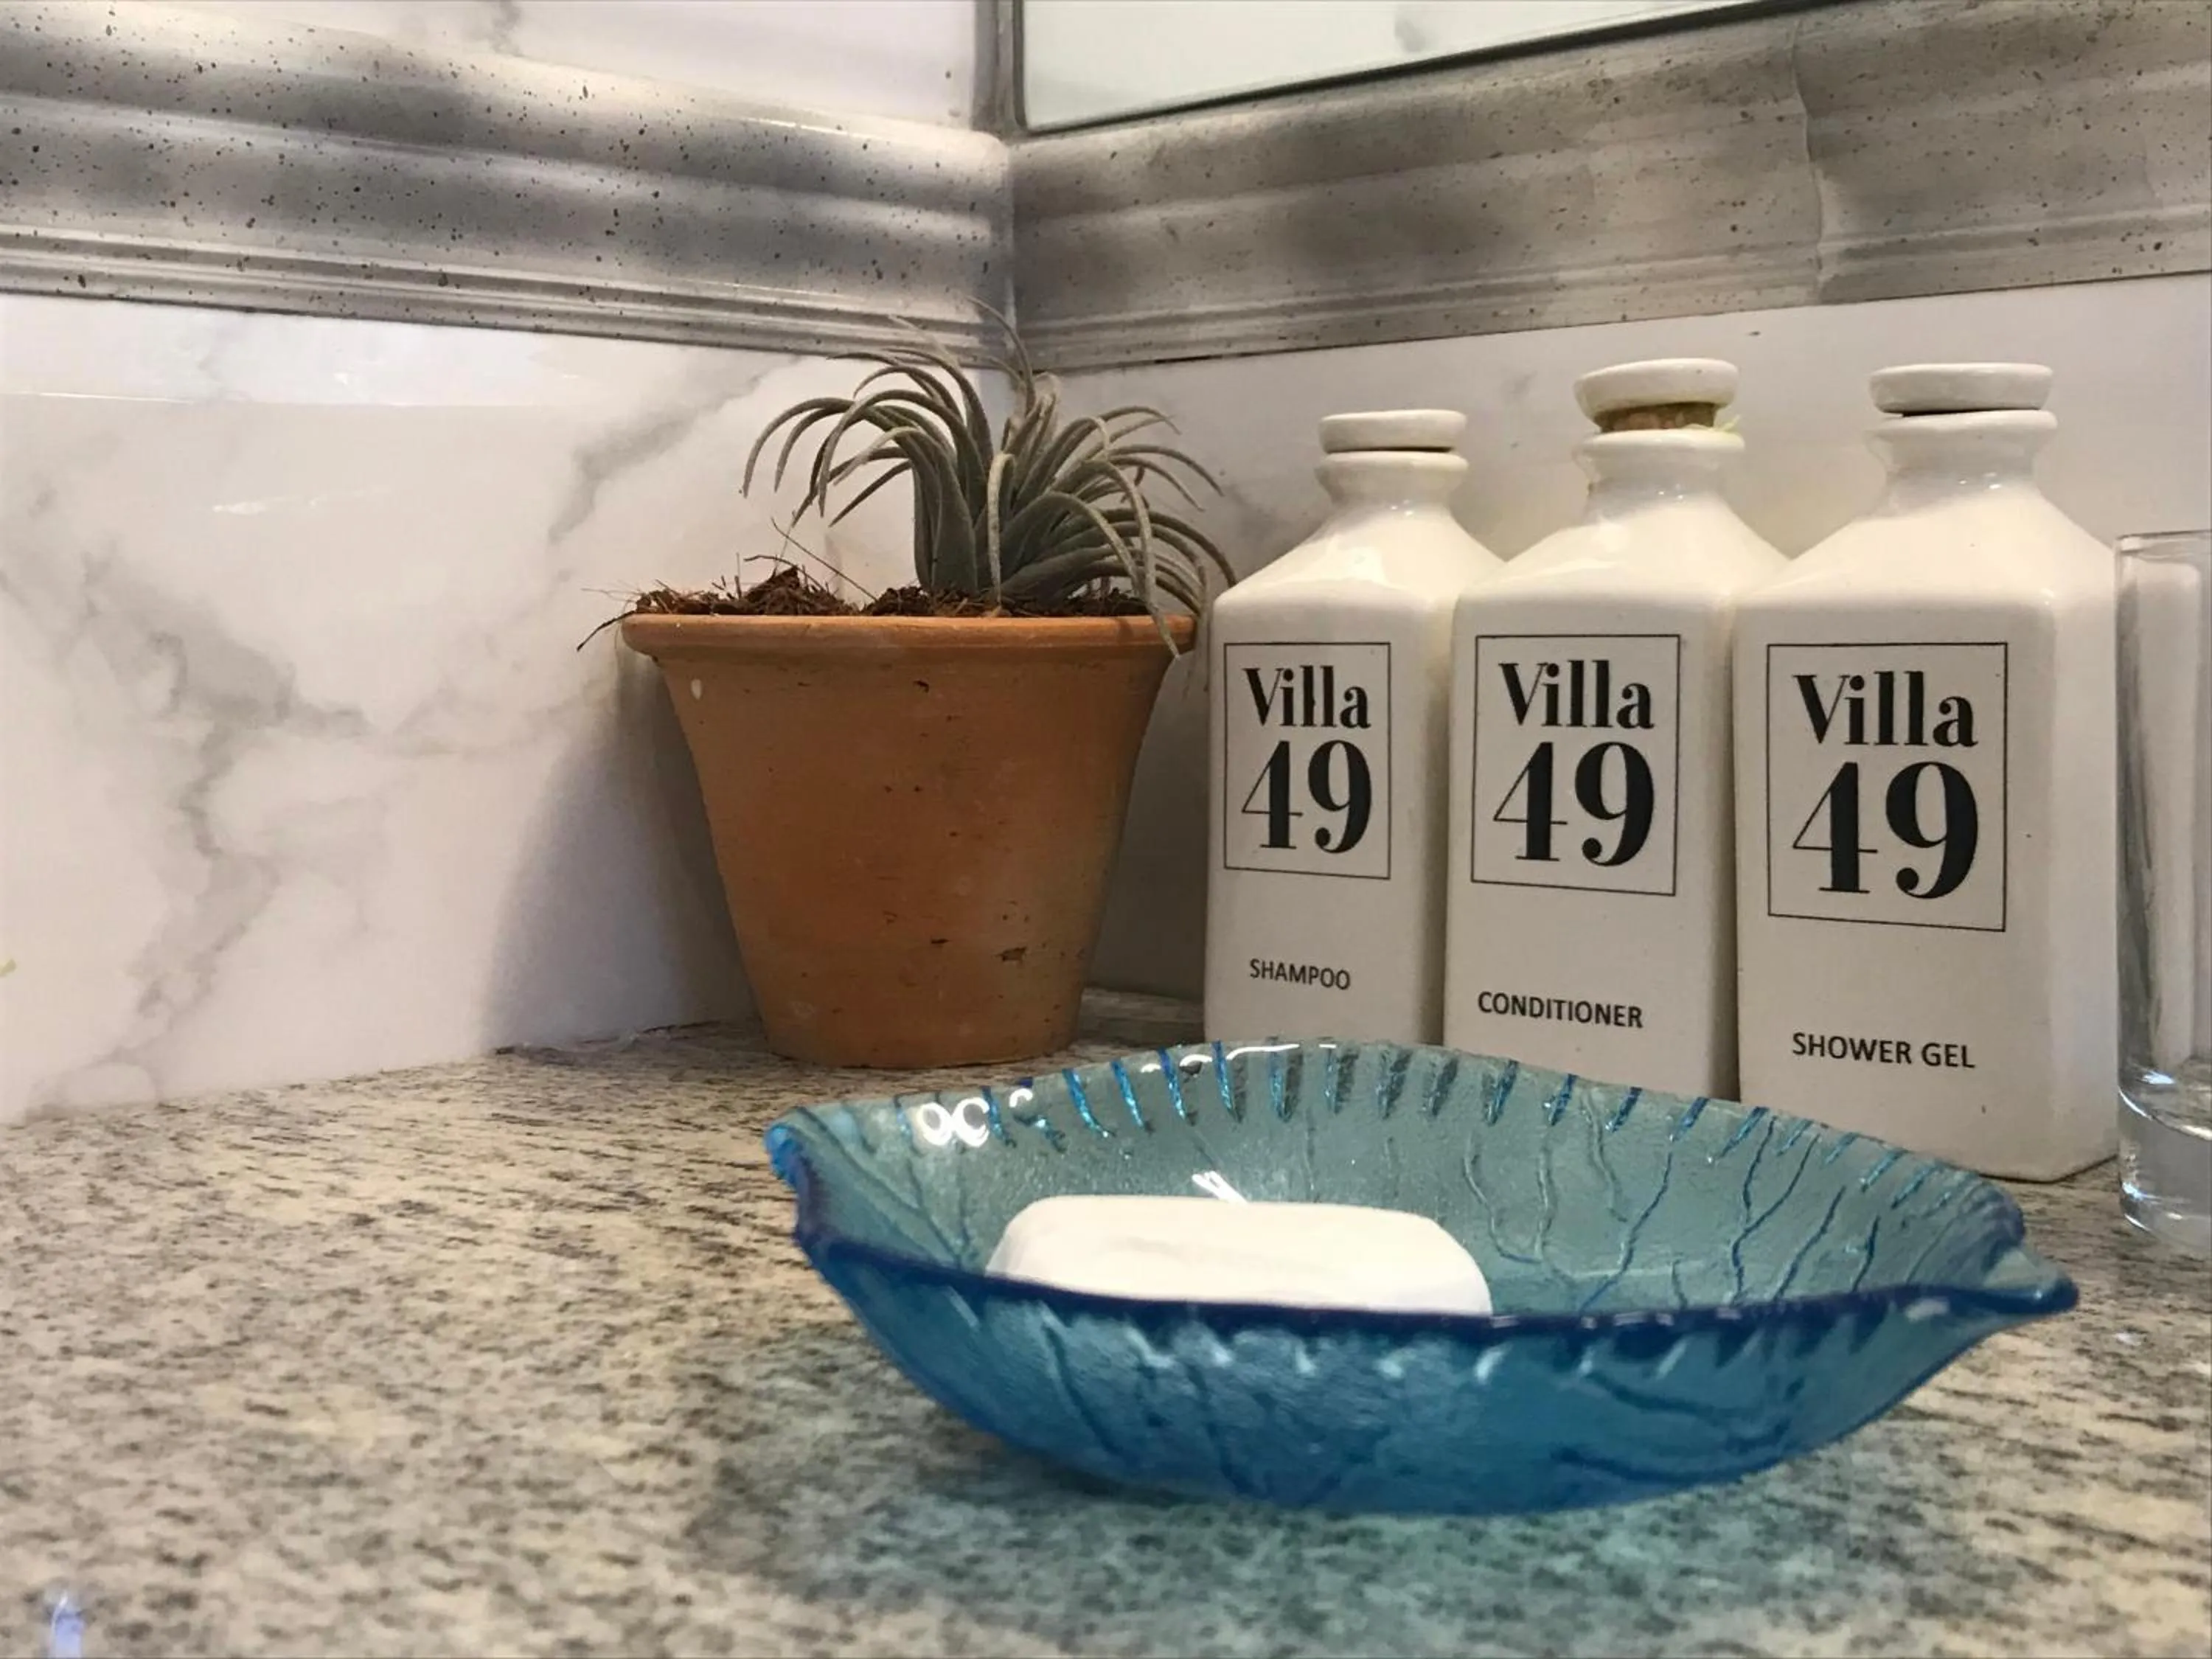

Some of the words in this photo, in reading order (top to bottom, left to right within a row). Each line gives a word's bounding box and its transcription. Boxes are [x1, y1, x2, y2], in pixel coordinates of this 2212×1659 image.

[1242, 665, 1371, 730] Villa
[1497, 660, 1655, 730] Villa
[1792, 670, 1979, 748] Villa
[1241, 740, 1372, 854] 49
[1492, 741, 1655, 867] 49
[1792, 761, 1979, 900] 49
[1249, 958, 1351, 990] SHAMPOO
[1478, 991, 1644, 1029] CONDITIONER
[1792, 1032, 1913, 1065] SHOWER
[1921, 1042, 1976, 1069] GEL
